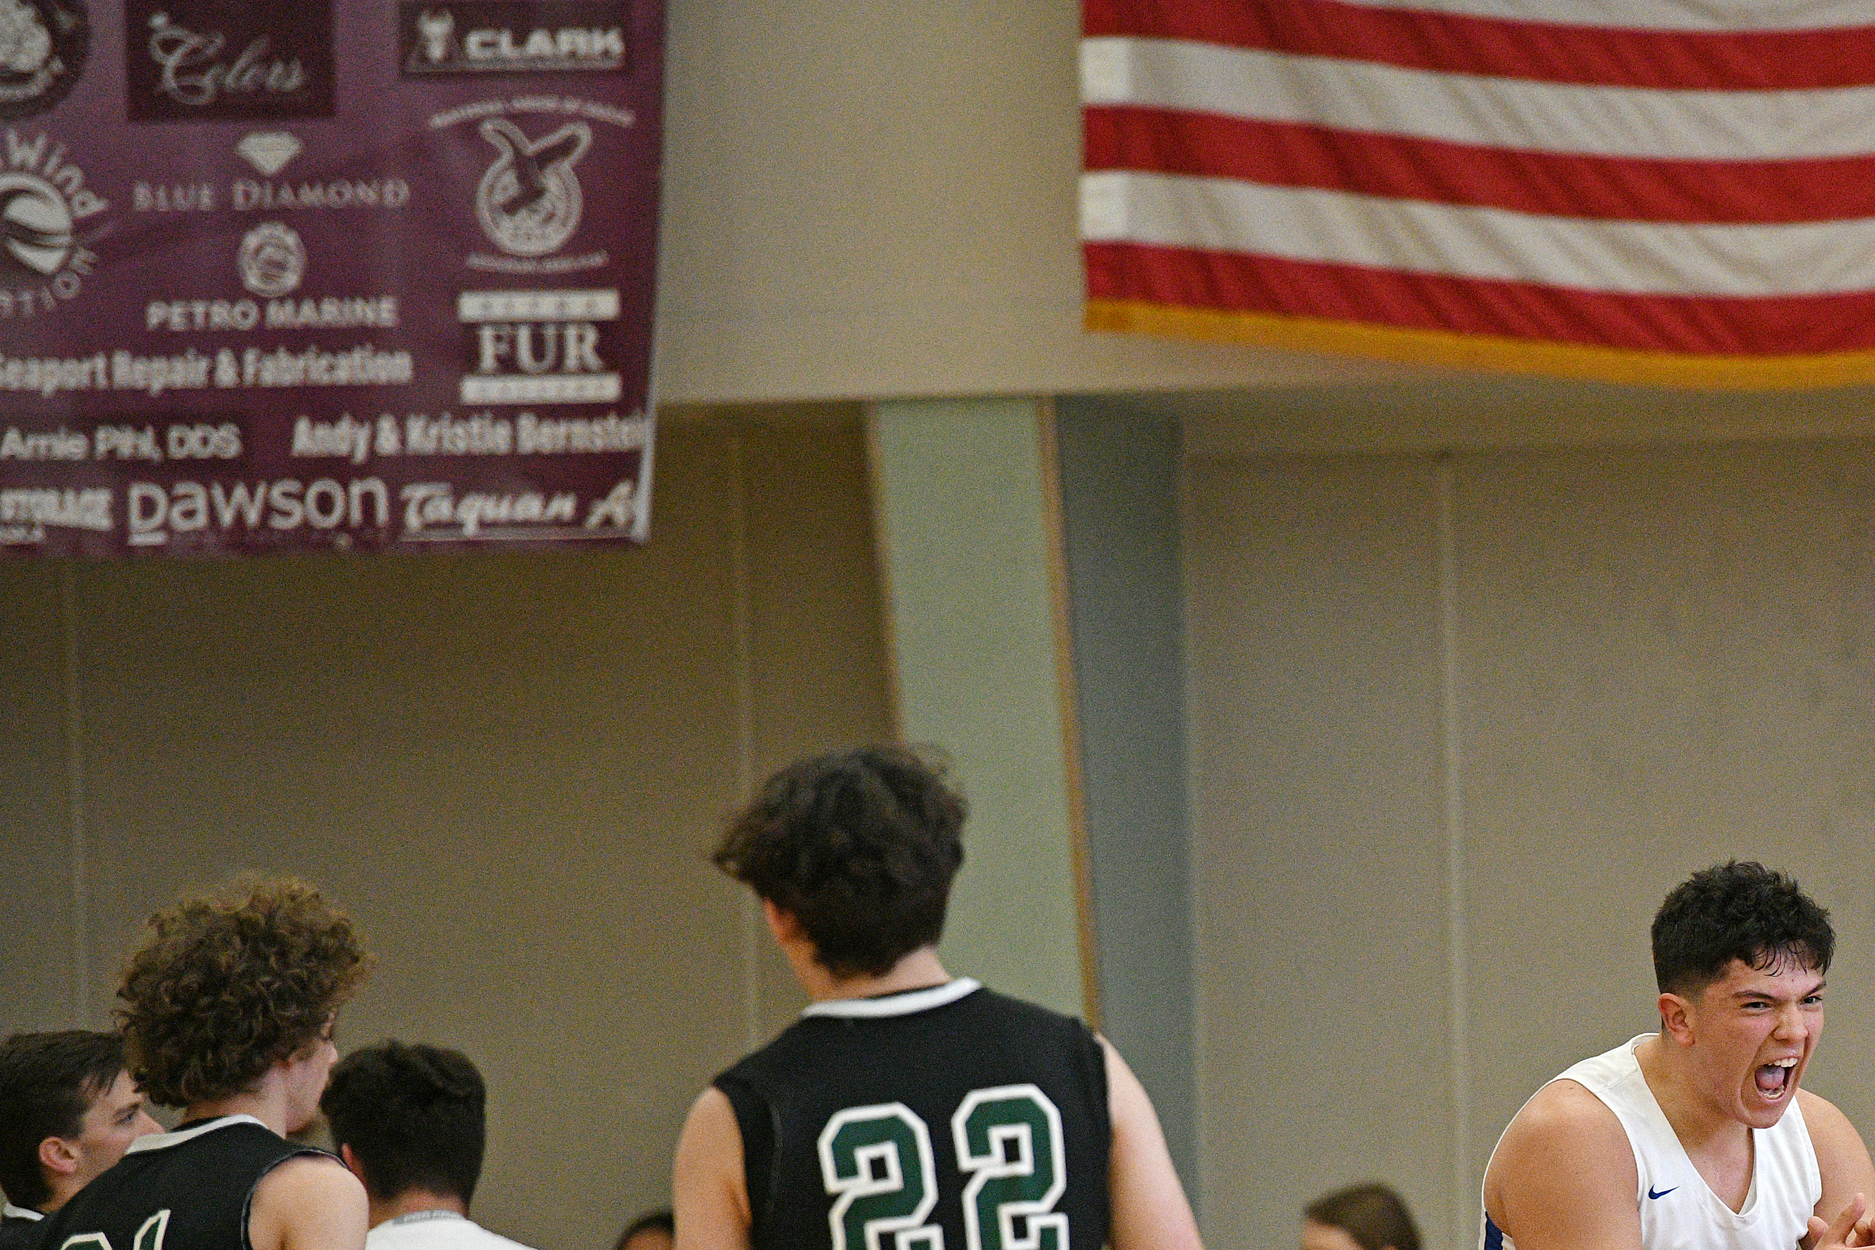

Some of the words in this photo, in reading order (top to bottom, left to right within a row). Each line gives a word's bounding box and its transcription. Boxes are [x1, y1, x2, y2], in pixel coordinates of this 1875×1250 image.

[465, 27, 625, 59] CLARK
[133, 182, 214, 211] BLUE
[232, 178, 410, 210] DIAMOND
[146, 301, 259, 331] PETRO
[265, 298, 398, 329] MARINE
[0, 352, 107, 397] eaport
[112, 349, 209, 397] Repair
[214, 350, 239, 388] &
[242, 343, 413, 387] Fabrication
[478, 322, 605, 374] FUR
[292, 412, 370, 464] Andy
[374, 413, 402, 456] &
[406, 411, 512, 456] Kristie
[401, 484, 577, 537] Taquan
